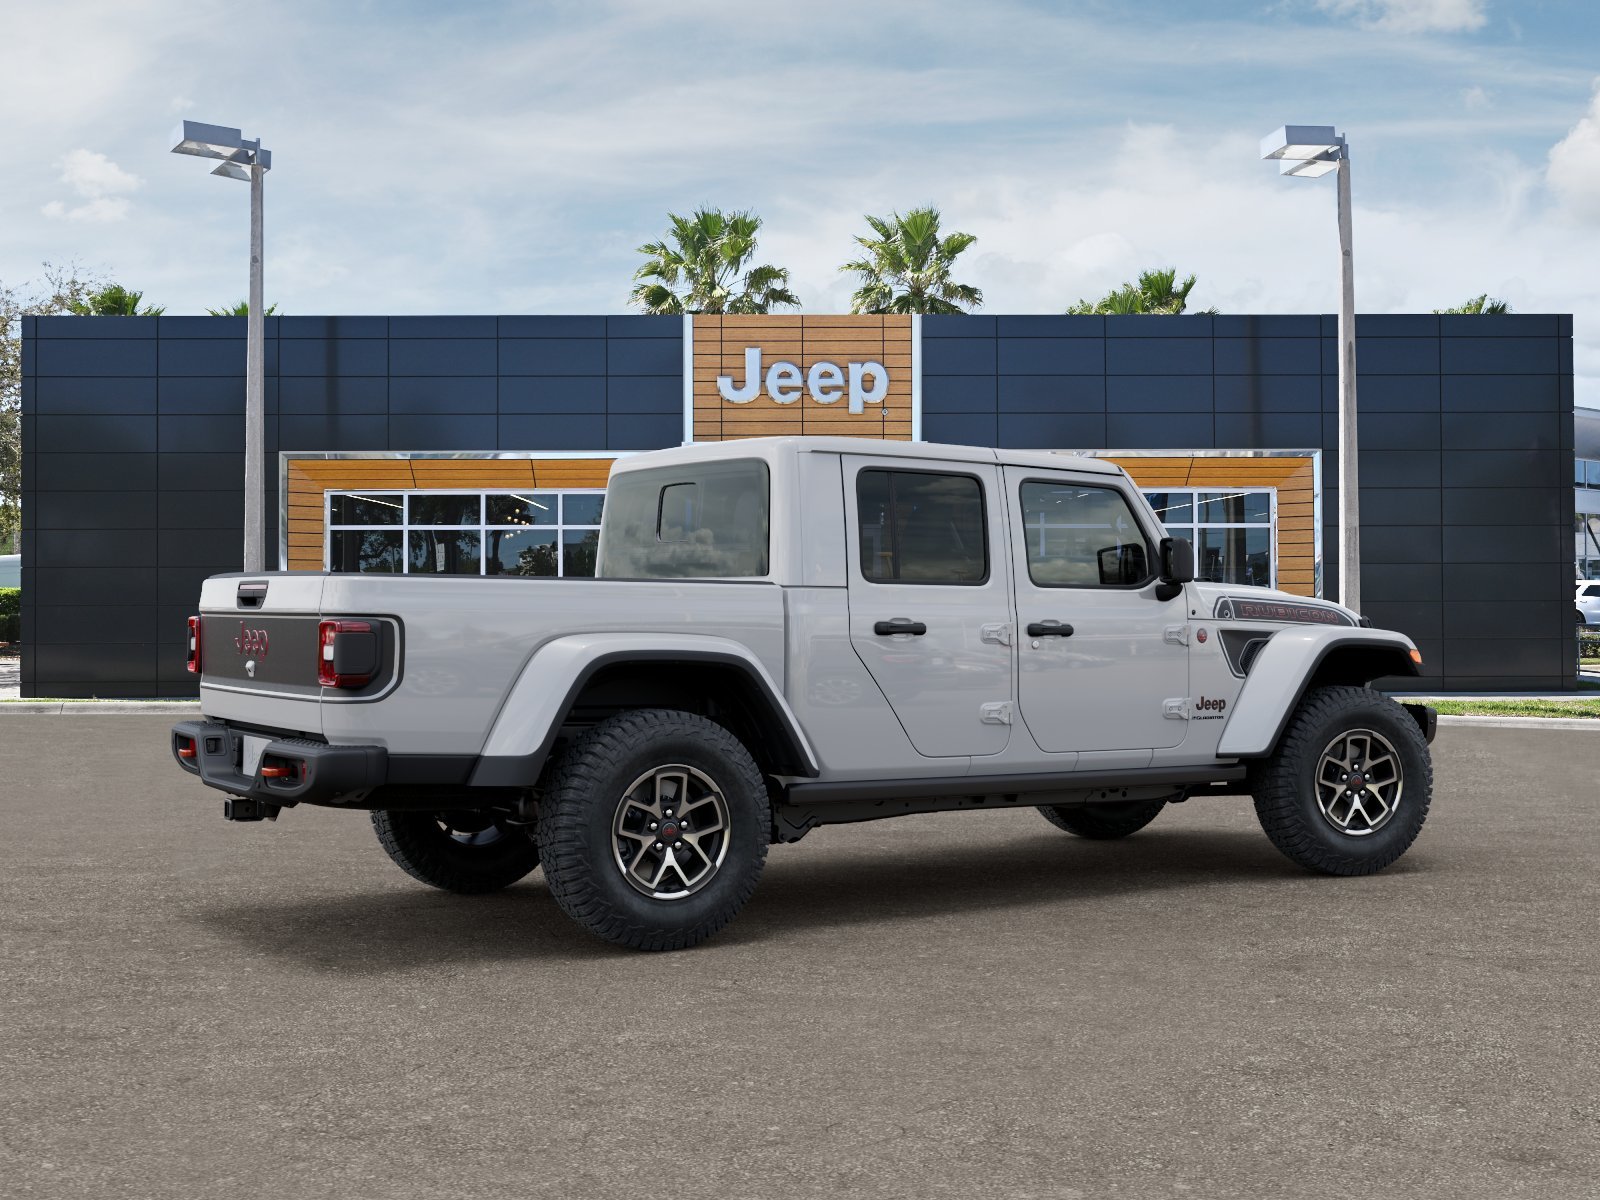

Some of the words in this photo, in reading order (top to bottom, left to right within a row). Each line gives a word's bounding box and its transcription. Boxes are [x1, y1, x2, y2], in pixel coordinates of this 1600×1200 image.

[716, 347, 889, 415] Jeep
[1241, 604, 1338, 623] RUBICON
[234, 620, 269, 663] Jeep
[1196, 696, 1226, 712] Jeep
